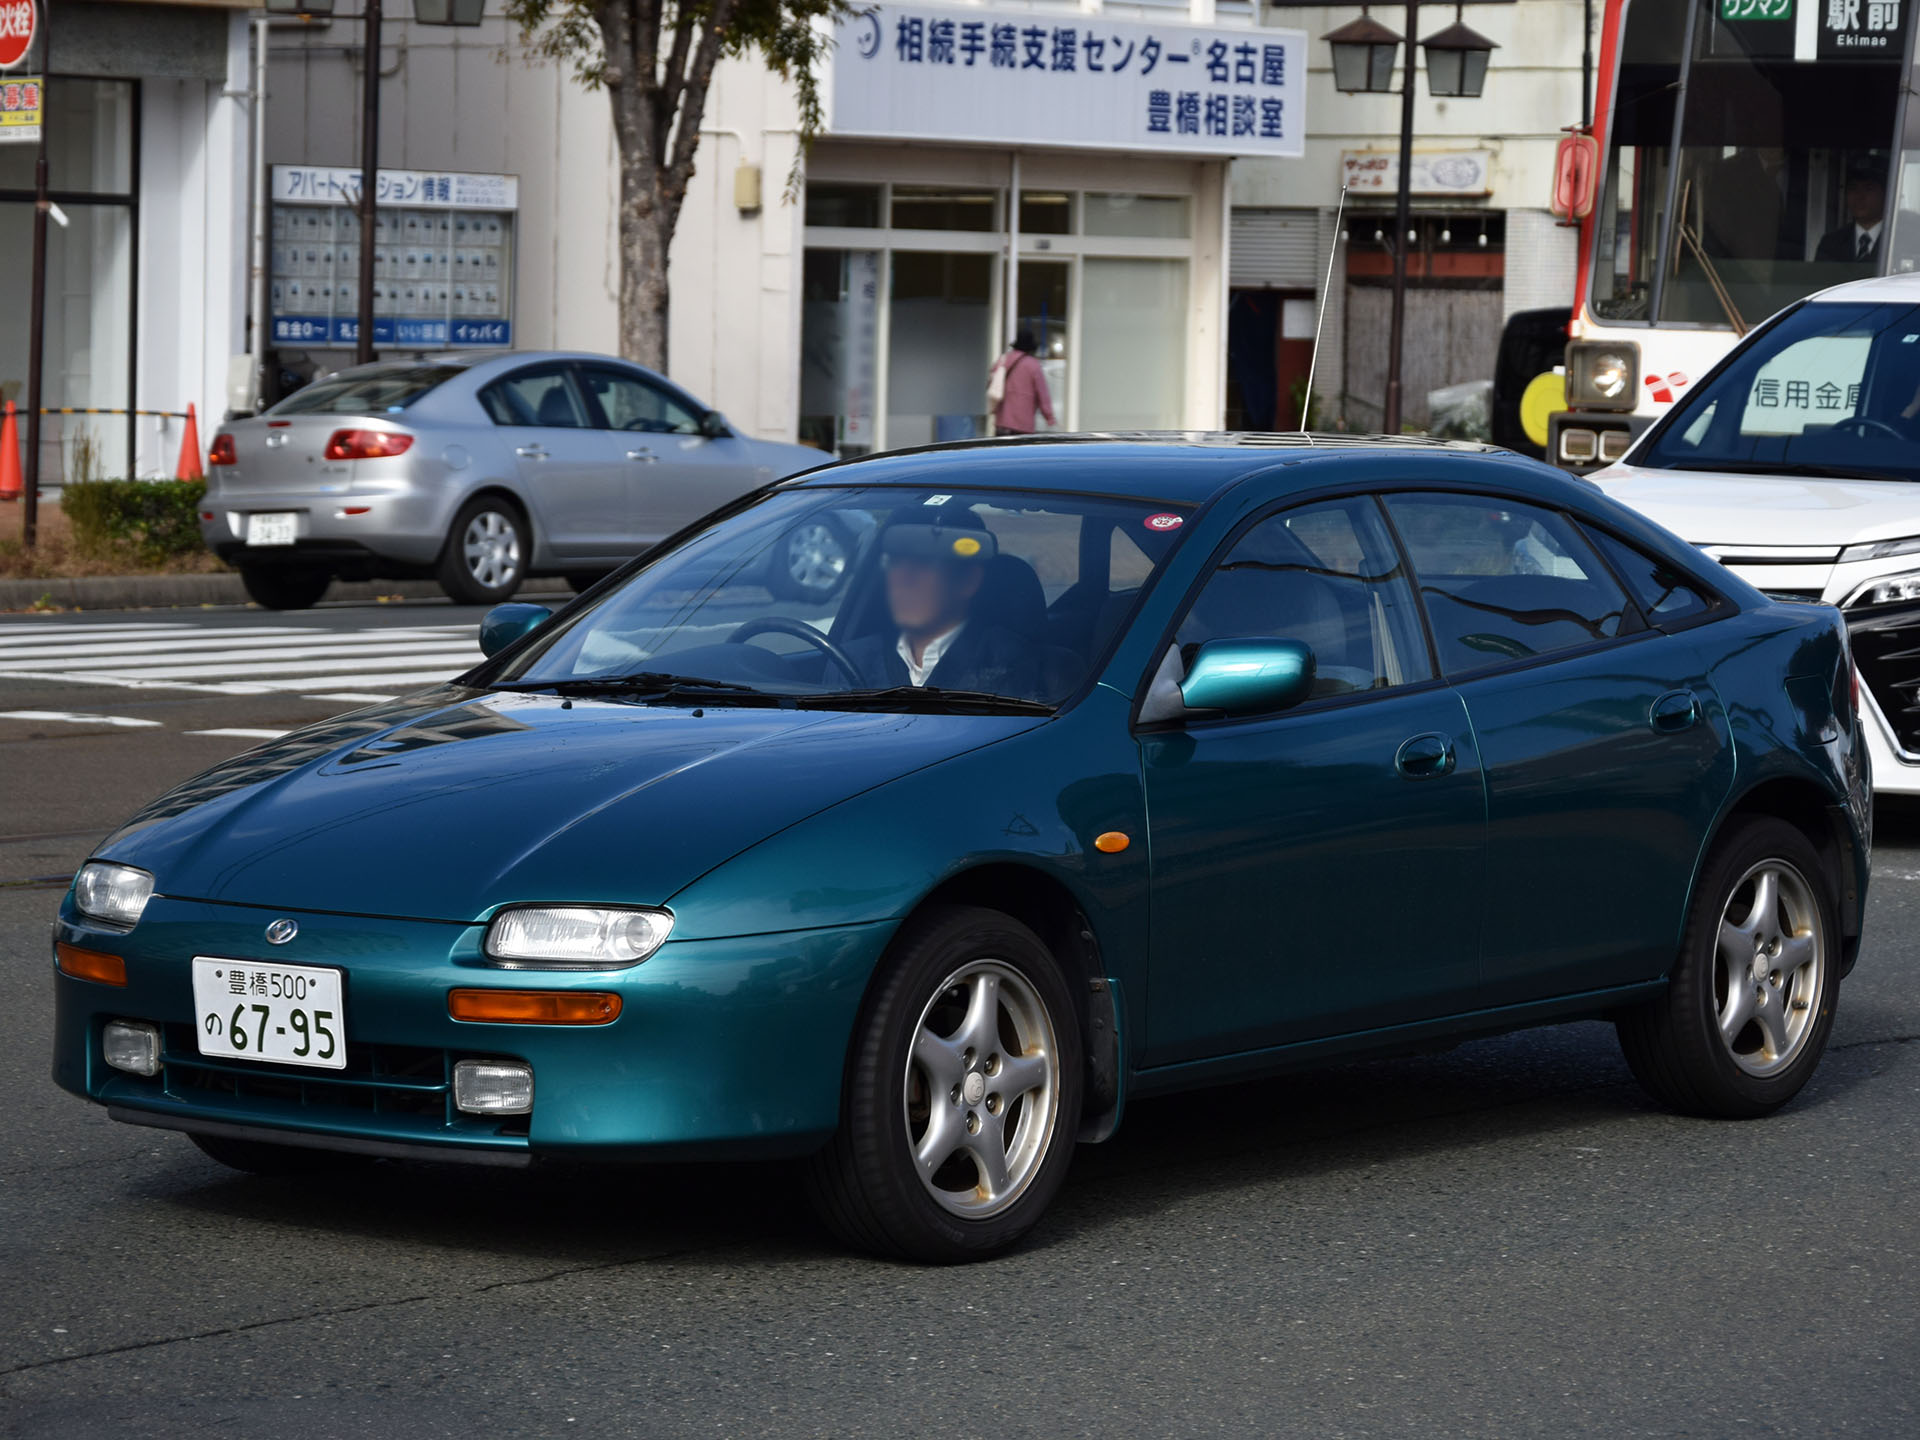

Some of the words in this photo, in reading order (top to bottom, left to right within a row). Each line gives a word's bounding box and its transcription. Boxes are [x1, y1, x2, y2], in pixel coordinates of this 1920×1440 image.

[1725, 0, 1789, 17] ワンマン
[1826, 0, 1901, 31] 駅前
[1836, 34, 1887, 47] Ekimae
[1146, 89, 1284, 138] 豊橋相談室
[204, 1012, 223, 1036] の
[229, 1003, 336, 1060] 67-95
